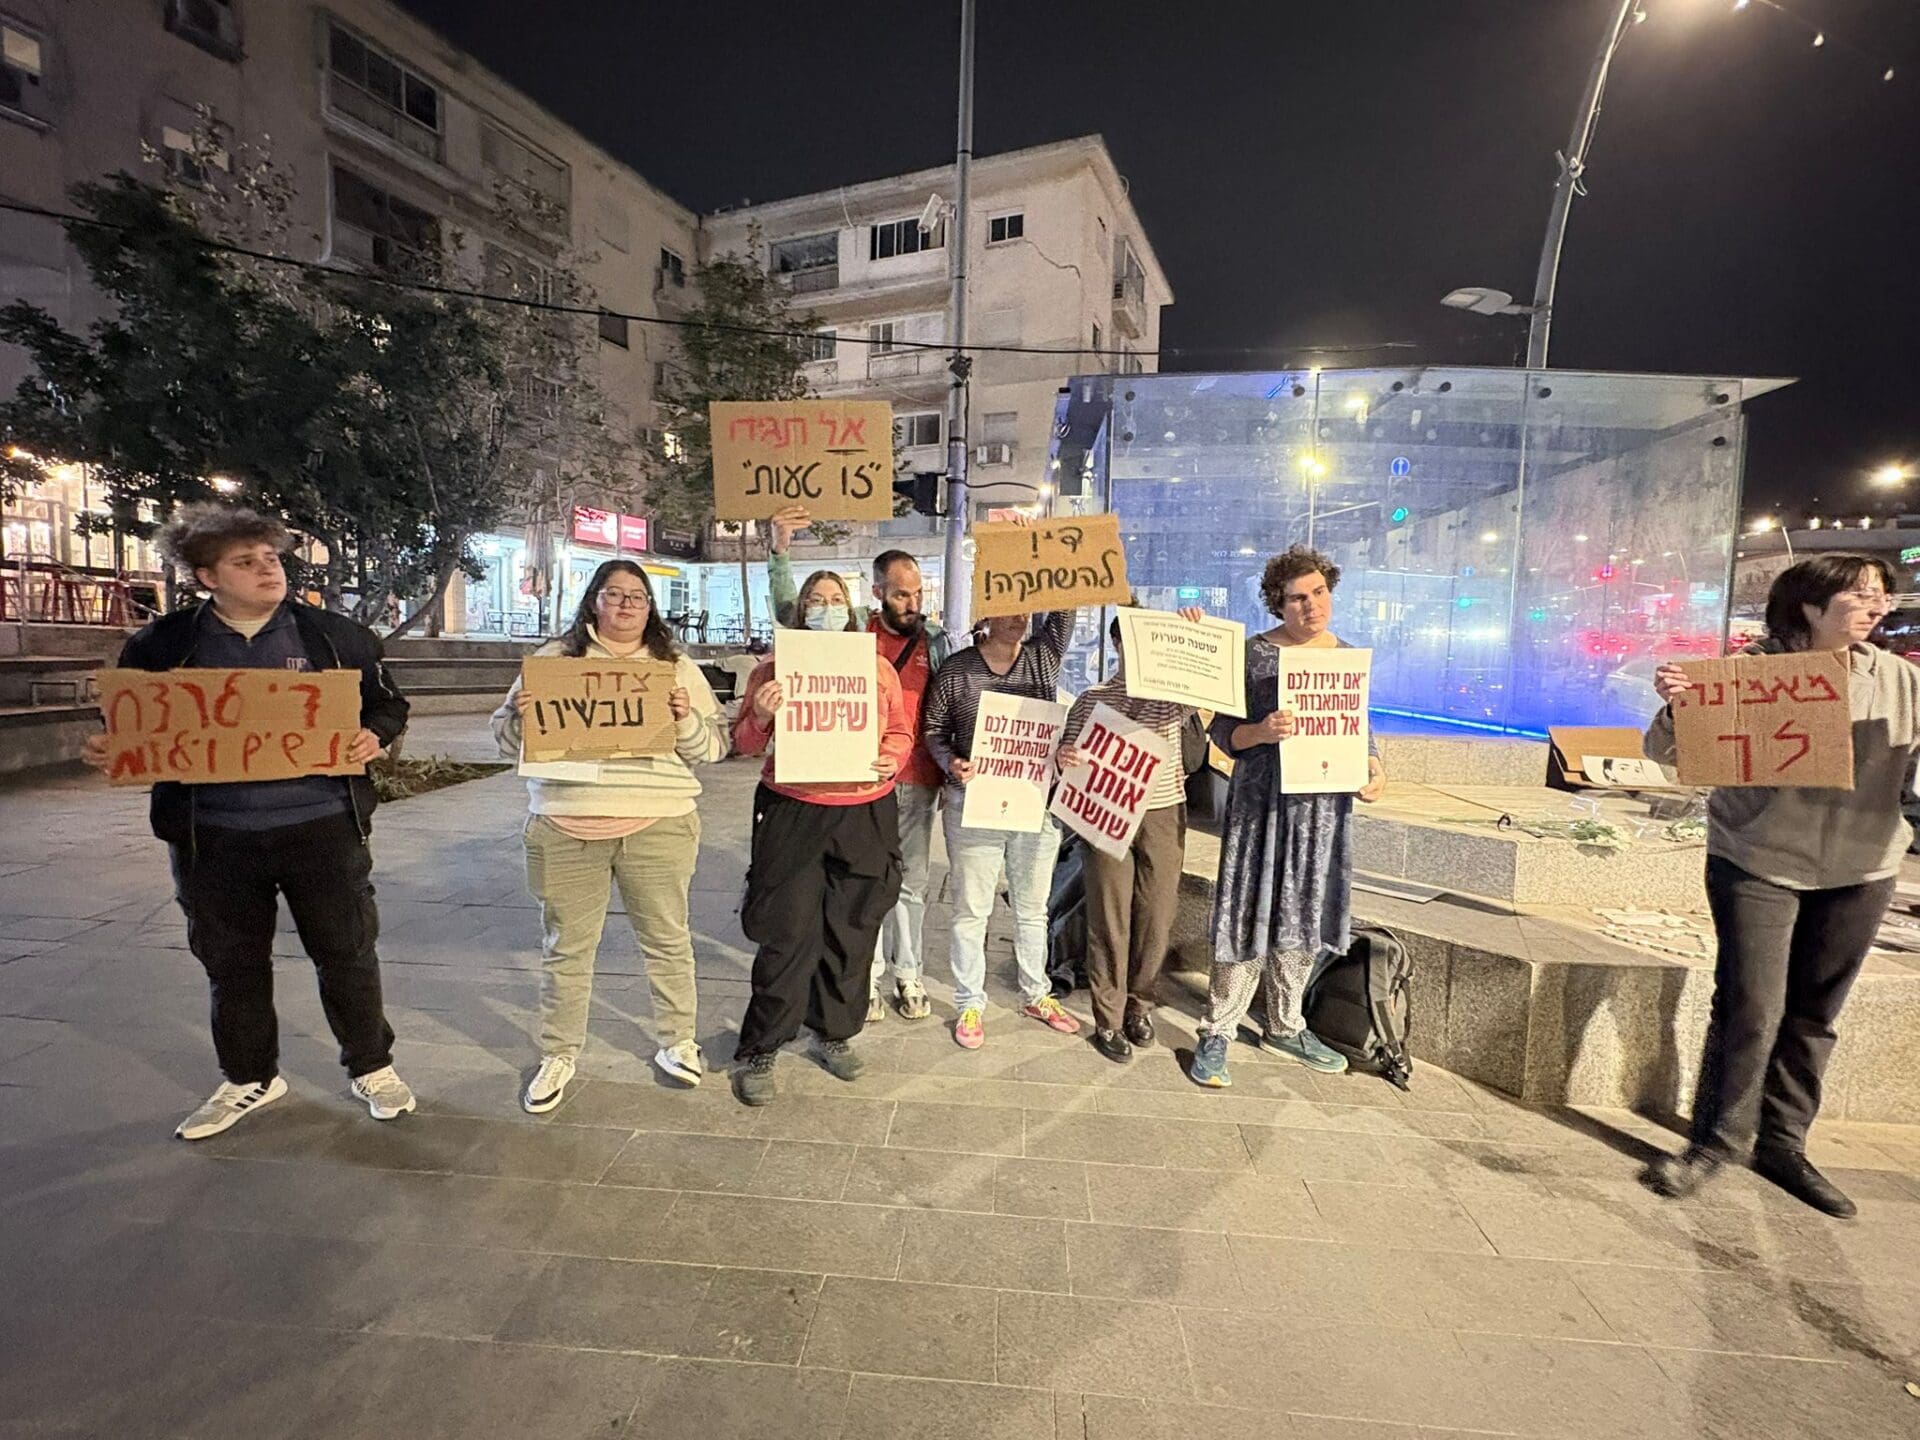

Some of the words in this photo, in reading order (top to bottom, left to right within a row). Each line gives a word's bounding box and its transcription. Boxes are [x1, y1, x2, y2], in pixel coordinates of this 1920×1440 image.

[817, 410, 866, 446] אל
[984, 549, 1118, 602] להשתקה!
[581, 671, 651, 698] צדק
[785, 670, 804, 698] לך
[807, 674, 868, 695] מאמינות
[1287, 669, 1310, 690] לכם
[1312, 672, 1340, 690] יגידו
[1294, 693, 1360, 711] שהתאבדתי
[984, 714, 1009, 734] לכם
[1010, 718, 1035, 738] יגידו
[1340, 712, 1360, 736] אל
[990, 736, 1050, 759] שהתאבדתי
[1080, 722, 1162, 785] זוכרות
[1717, 719, 1811, 783] לך
[1027, 759, 1047, 782] אל
[1085, 759, 1146, 815] אותך
[1060, 781, 1131, 841] שושנה
